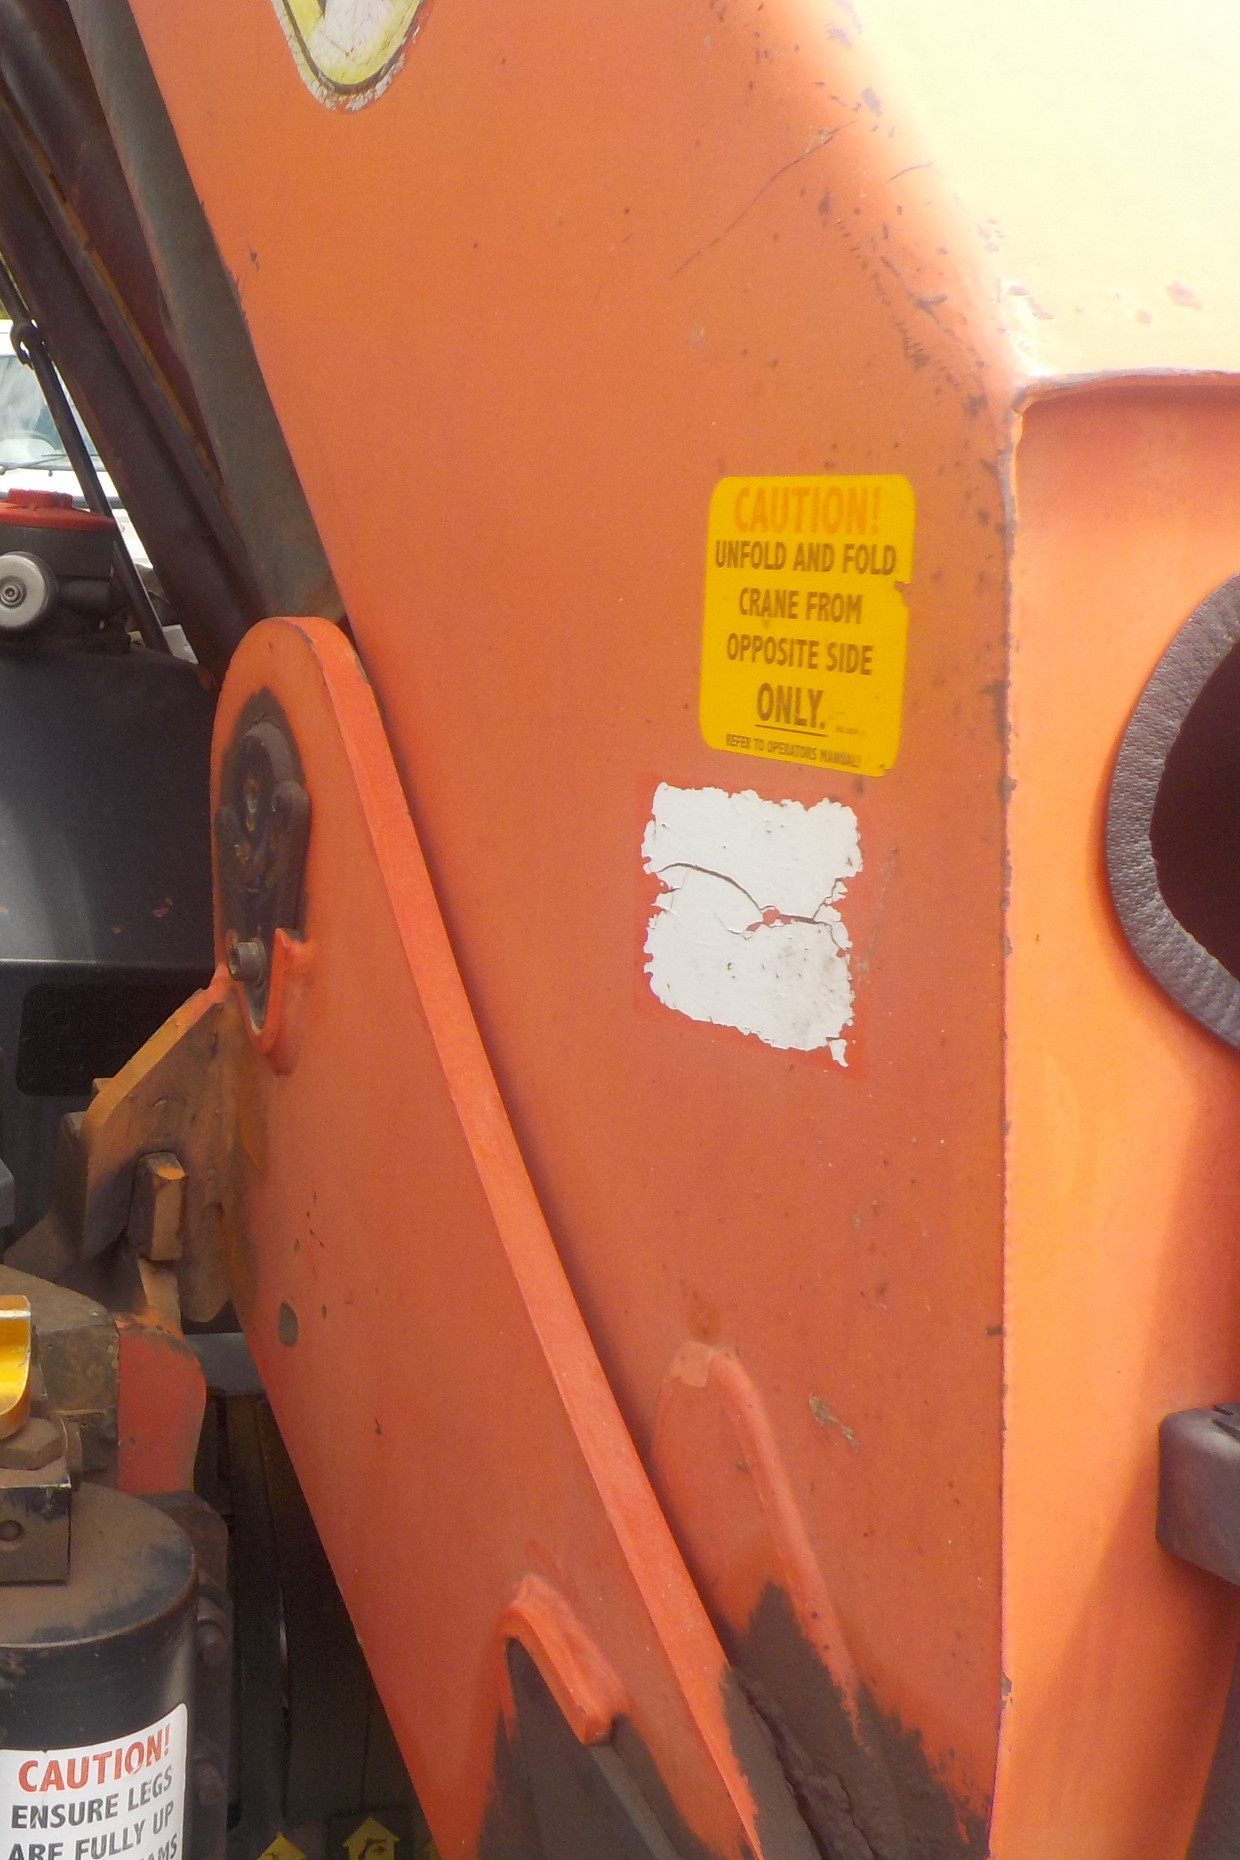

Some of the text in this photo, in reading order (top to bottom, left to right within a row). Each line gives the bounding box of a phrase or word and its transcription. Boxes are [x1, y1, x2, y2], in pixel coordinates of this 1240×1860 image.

[734, 486, 881, 535] CAUTION!
[715, 539, 896, 576] UNFOLD AND FOLD
[739, 587, 862, 625] CRANE FROM
[727, 633, 873, 676] OPPOSITE SIDE
[757, 682, 826, 730] ONLY.
[726, 733, 751, 749] REFER
[754, 738, 764, 751] TO
[18, 1723, 171, 1792] CAUTION!
[11, 1764, 173, 1829] ENSURE LEGS
[8, 1800, 174, 1860] ARE FULLY UP
